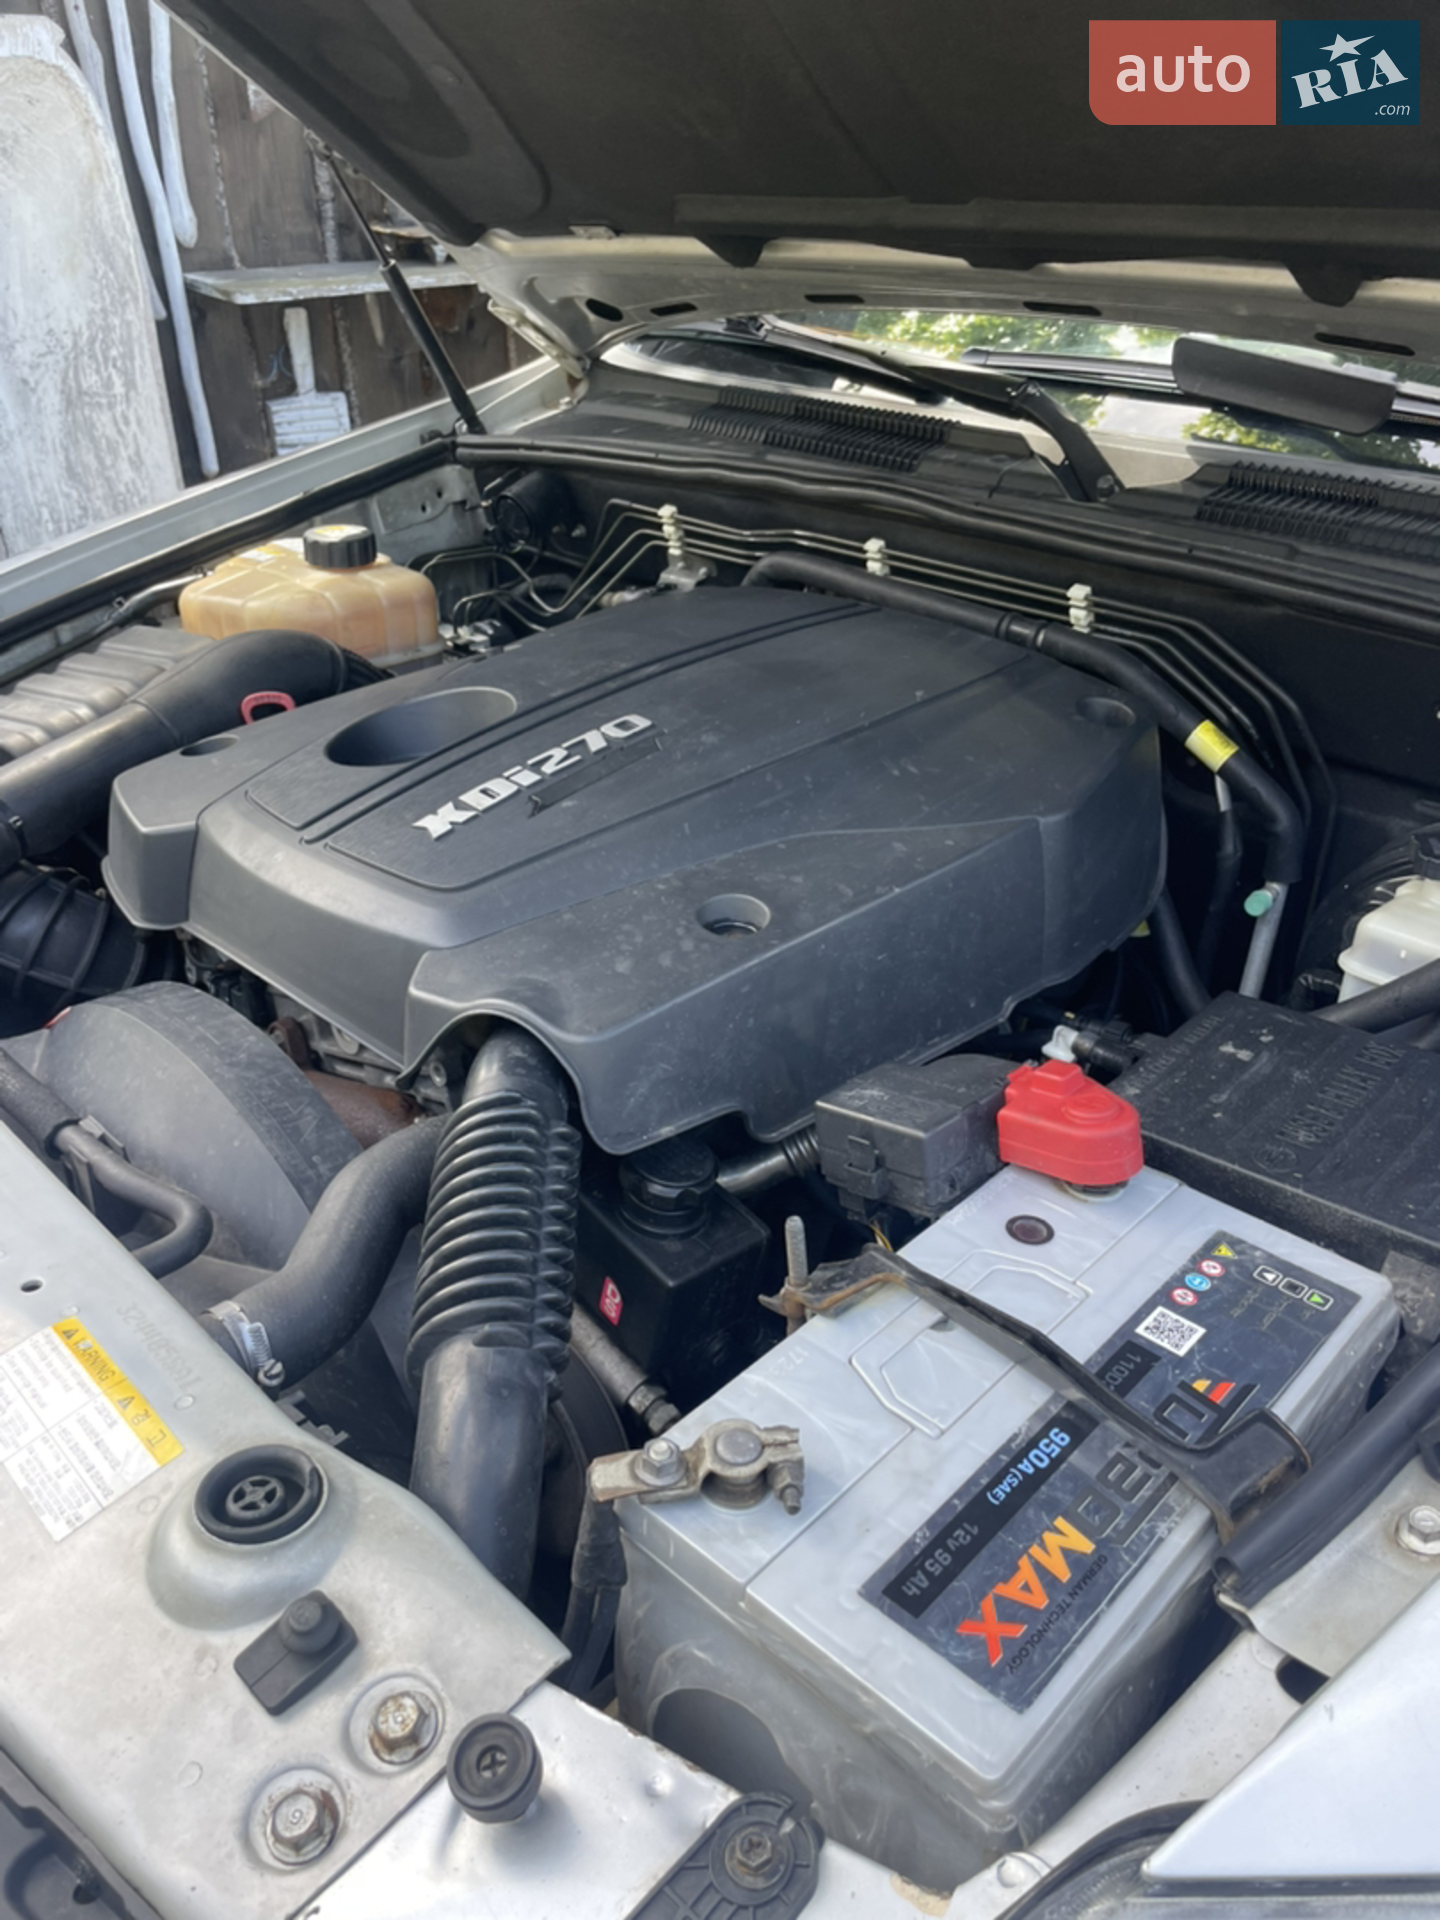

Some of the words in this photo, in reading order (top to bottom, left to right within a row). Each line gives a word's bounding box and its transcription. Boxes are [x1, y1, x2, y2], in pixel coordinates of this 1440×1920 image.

[1102, 1352, 1142, 1391] 110D
[924, 1548, 952, 1577] 95
[1069, 1553, 1108, 1600] GERMAN
[902, 1573, 929, 1598] Ah
[1007, 1596, 1071, 1675] TECHNOLOGY
